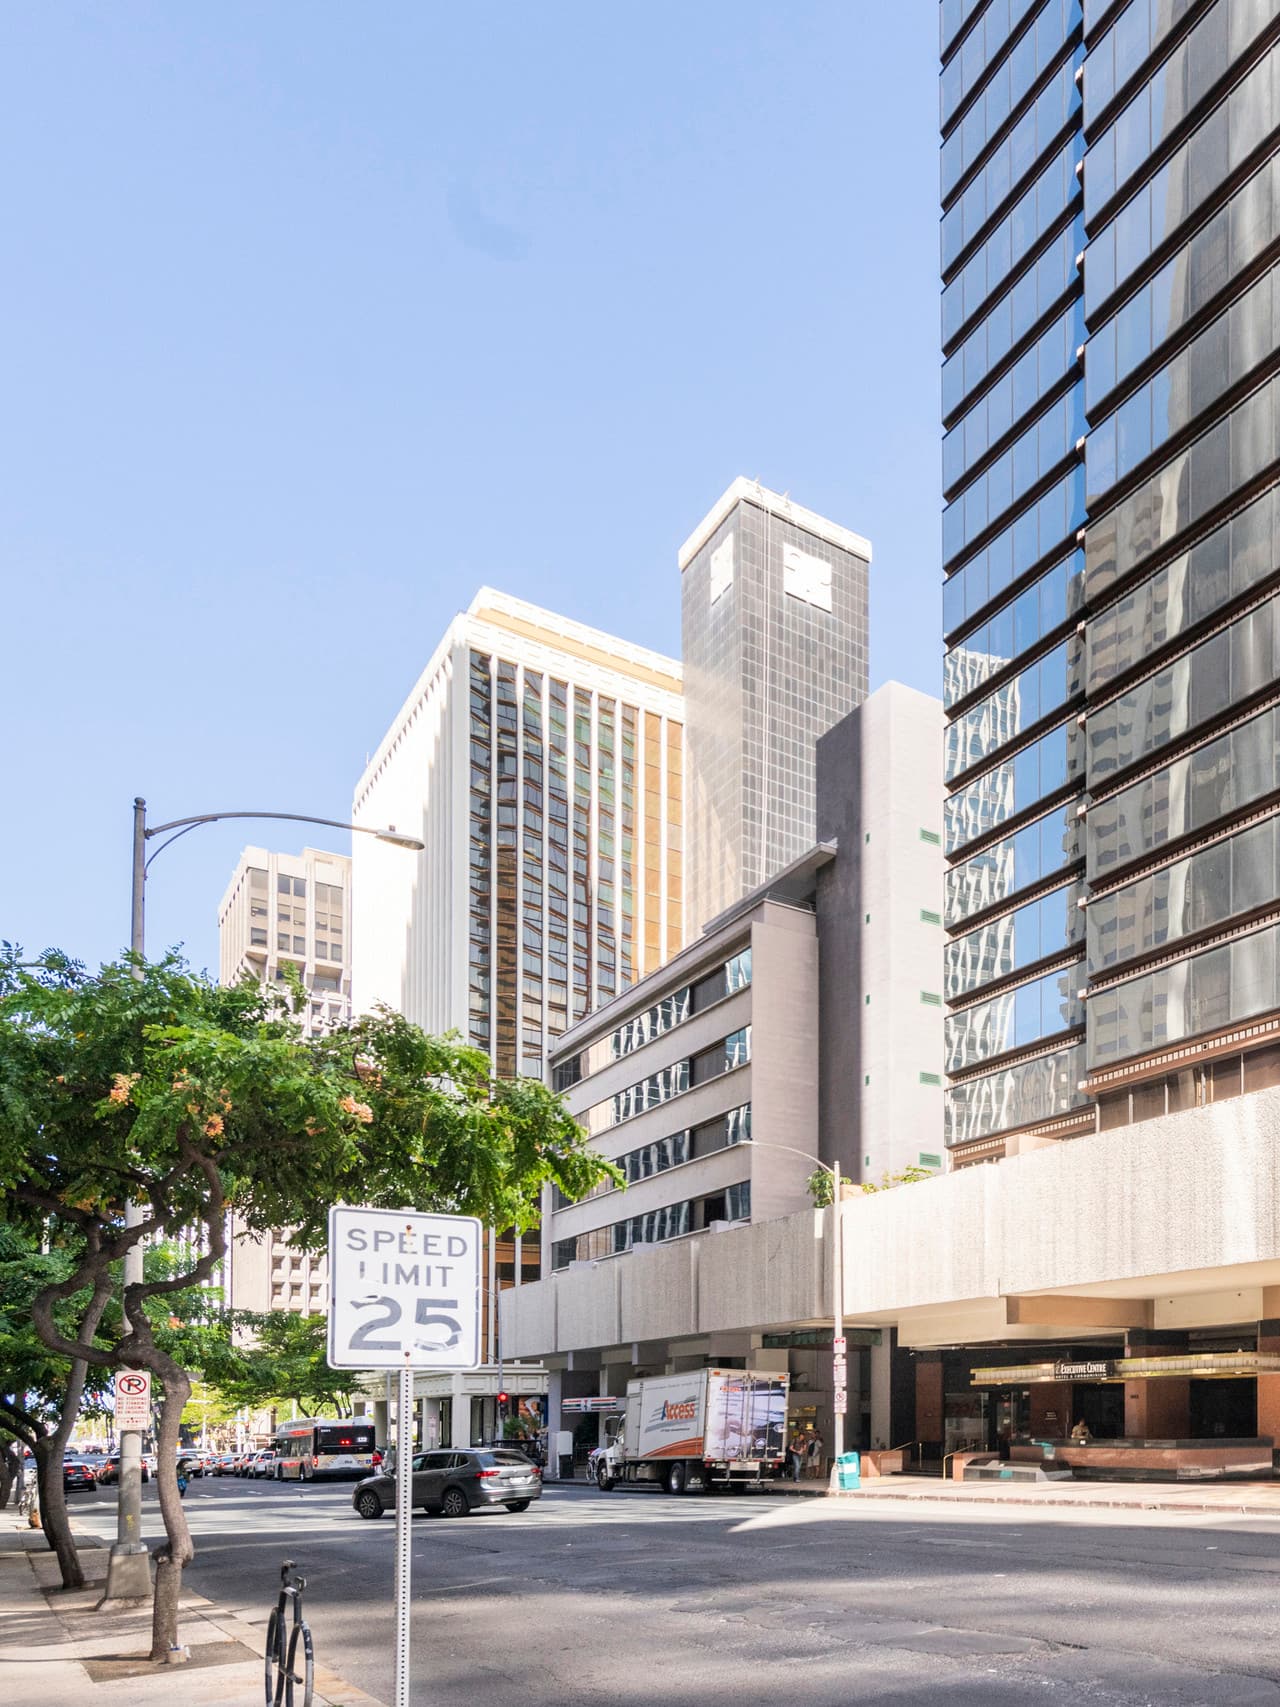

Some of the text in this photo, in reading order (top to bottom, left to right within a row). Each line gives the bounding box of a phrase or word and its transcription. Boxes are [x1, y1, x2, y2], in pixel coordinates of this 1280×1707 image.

[346, 1228, 468, 1257] SPEED
[348, 1296, 463, 1352] 25
[661, 1400, 695, 1421] Access
